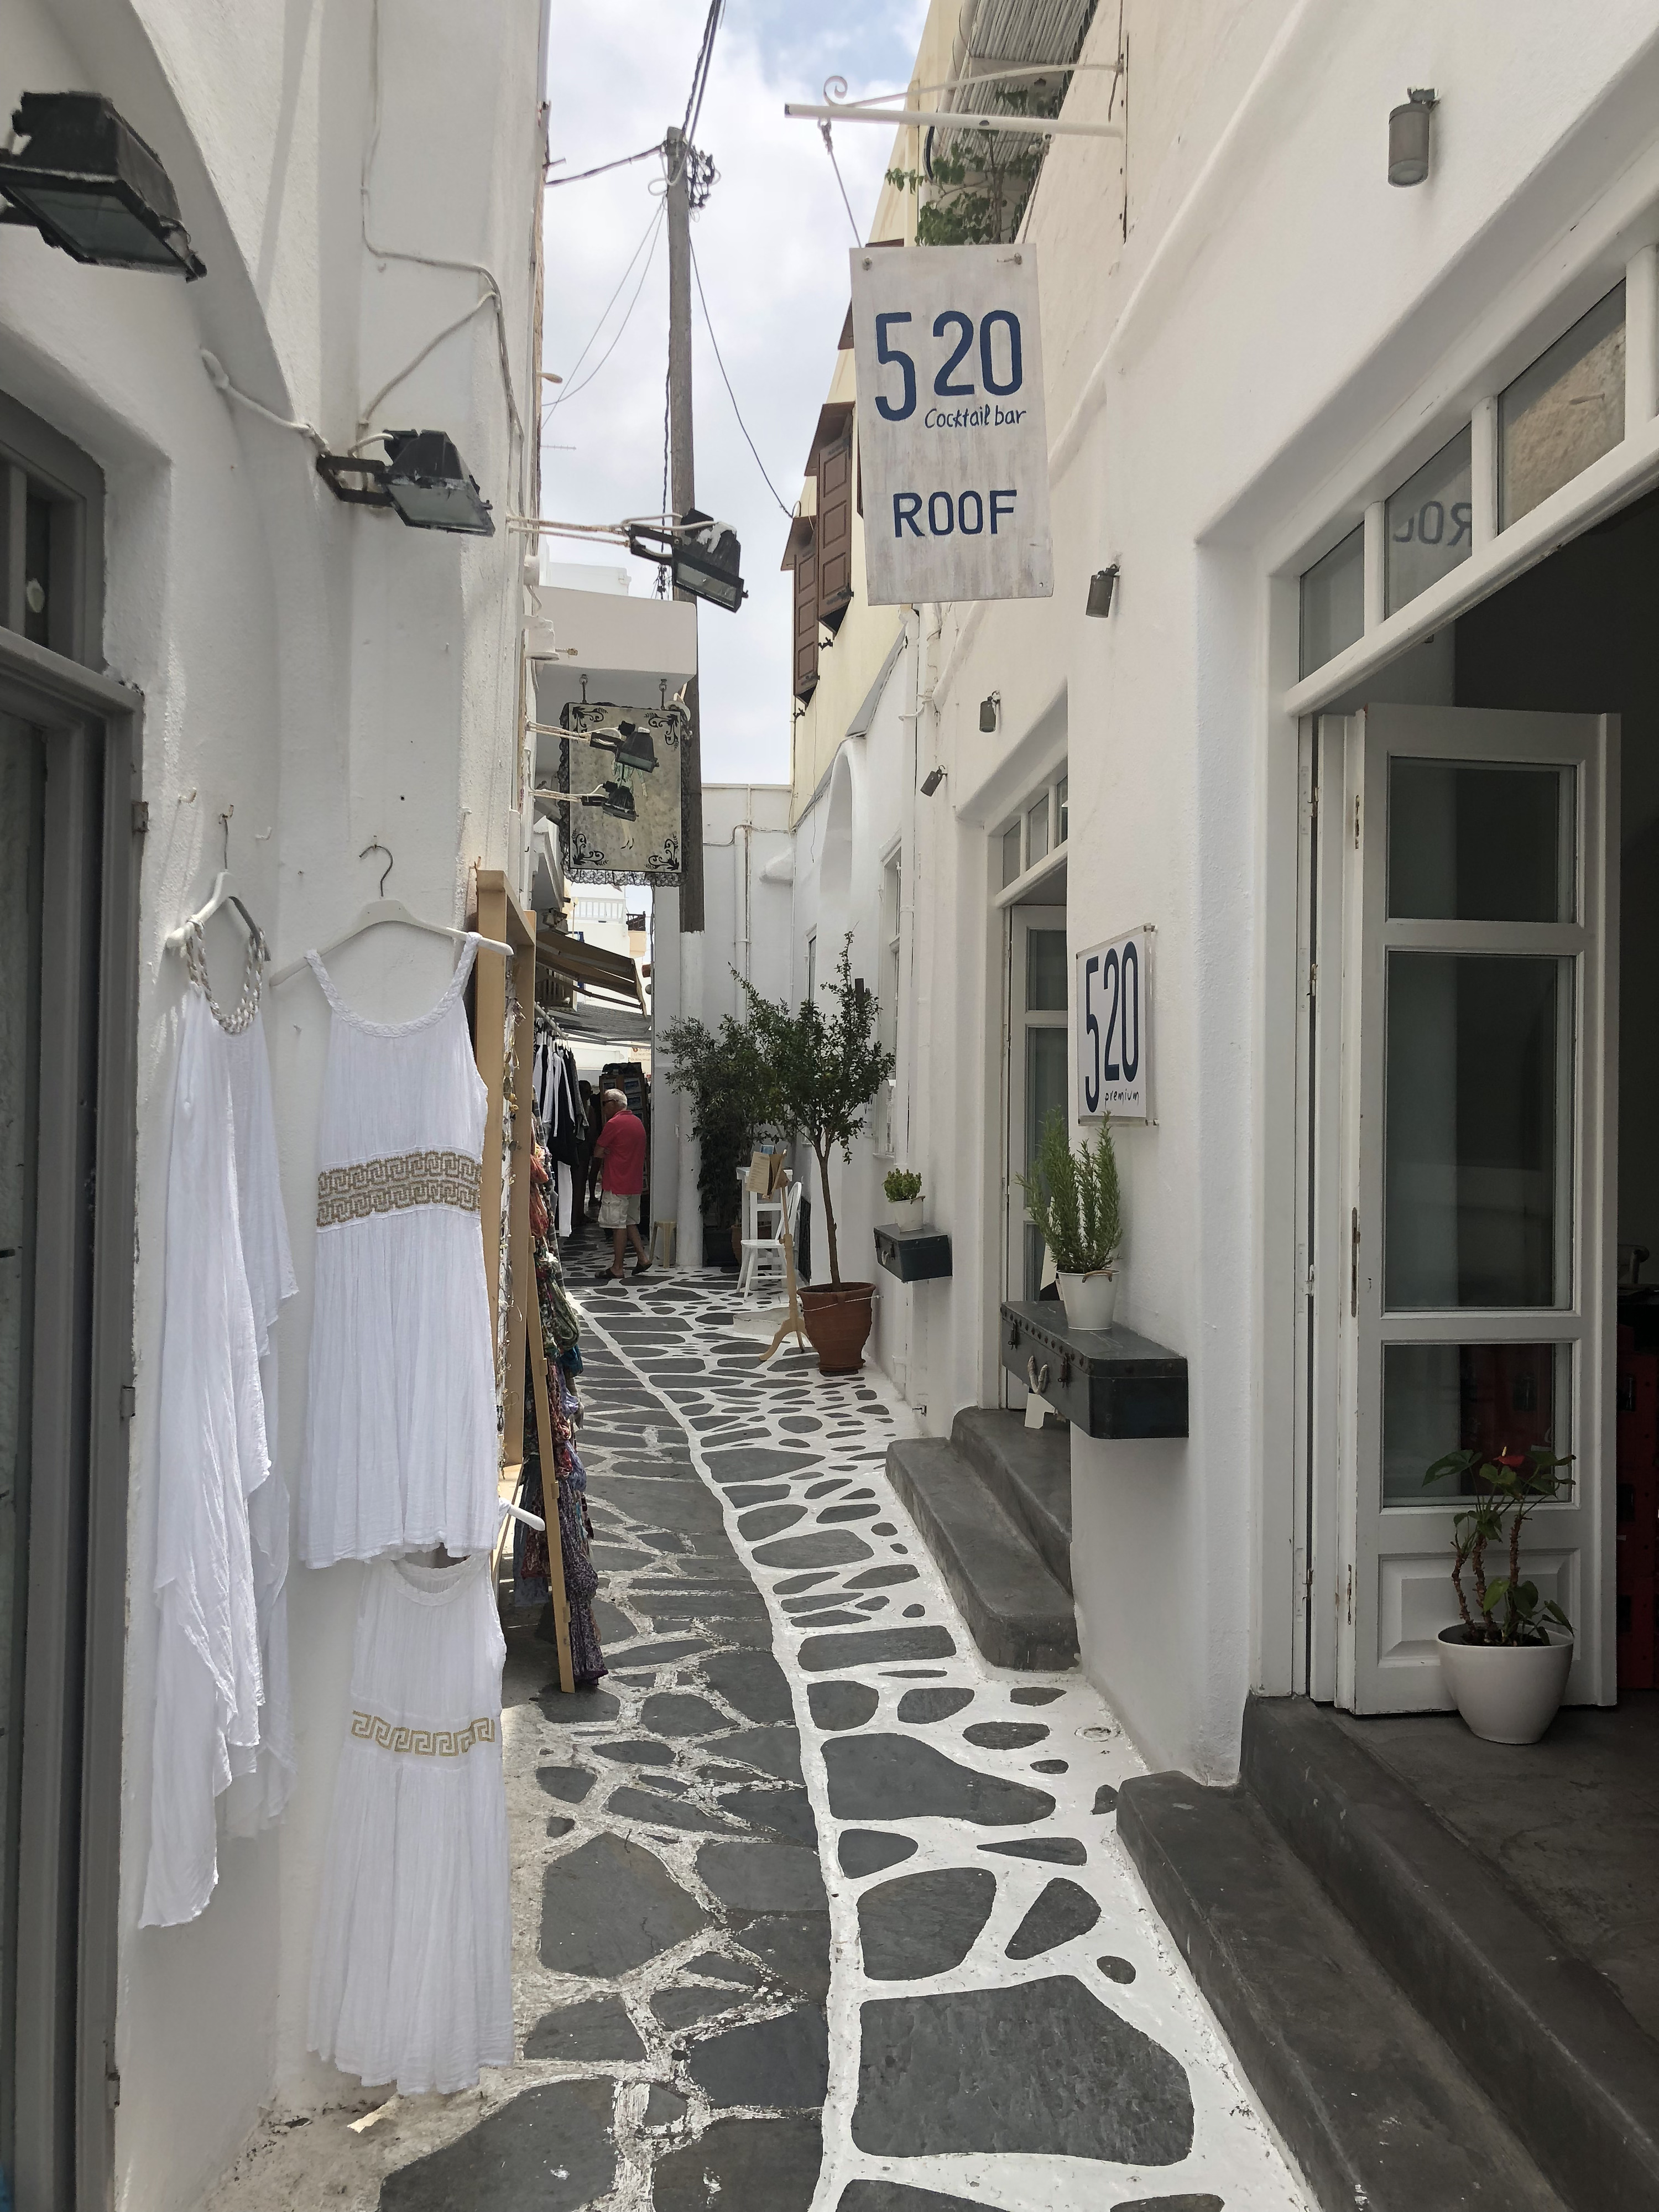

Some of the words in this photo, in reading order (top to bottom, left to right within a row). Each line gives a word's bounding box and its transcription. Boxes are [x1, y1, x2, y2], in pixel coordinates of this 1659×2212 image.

[875, 310, 1022, 422] 520
[925, 404, 991, 429] Cocktail
[995, 405, 1027, 426] bar
[893, 490, 1018, 538] ROOF
[1085, 941, 1139, 1113] 520
[1104, 1088, 1139, 1108] premium
